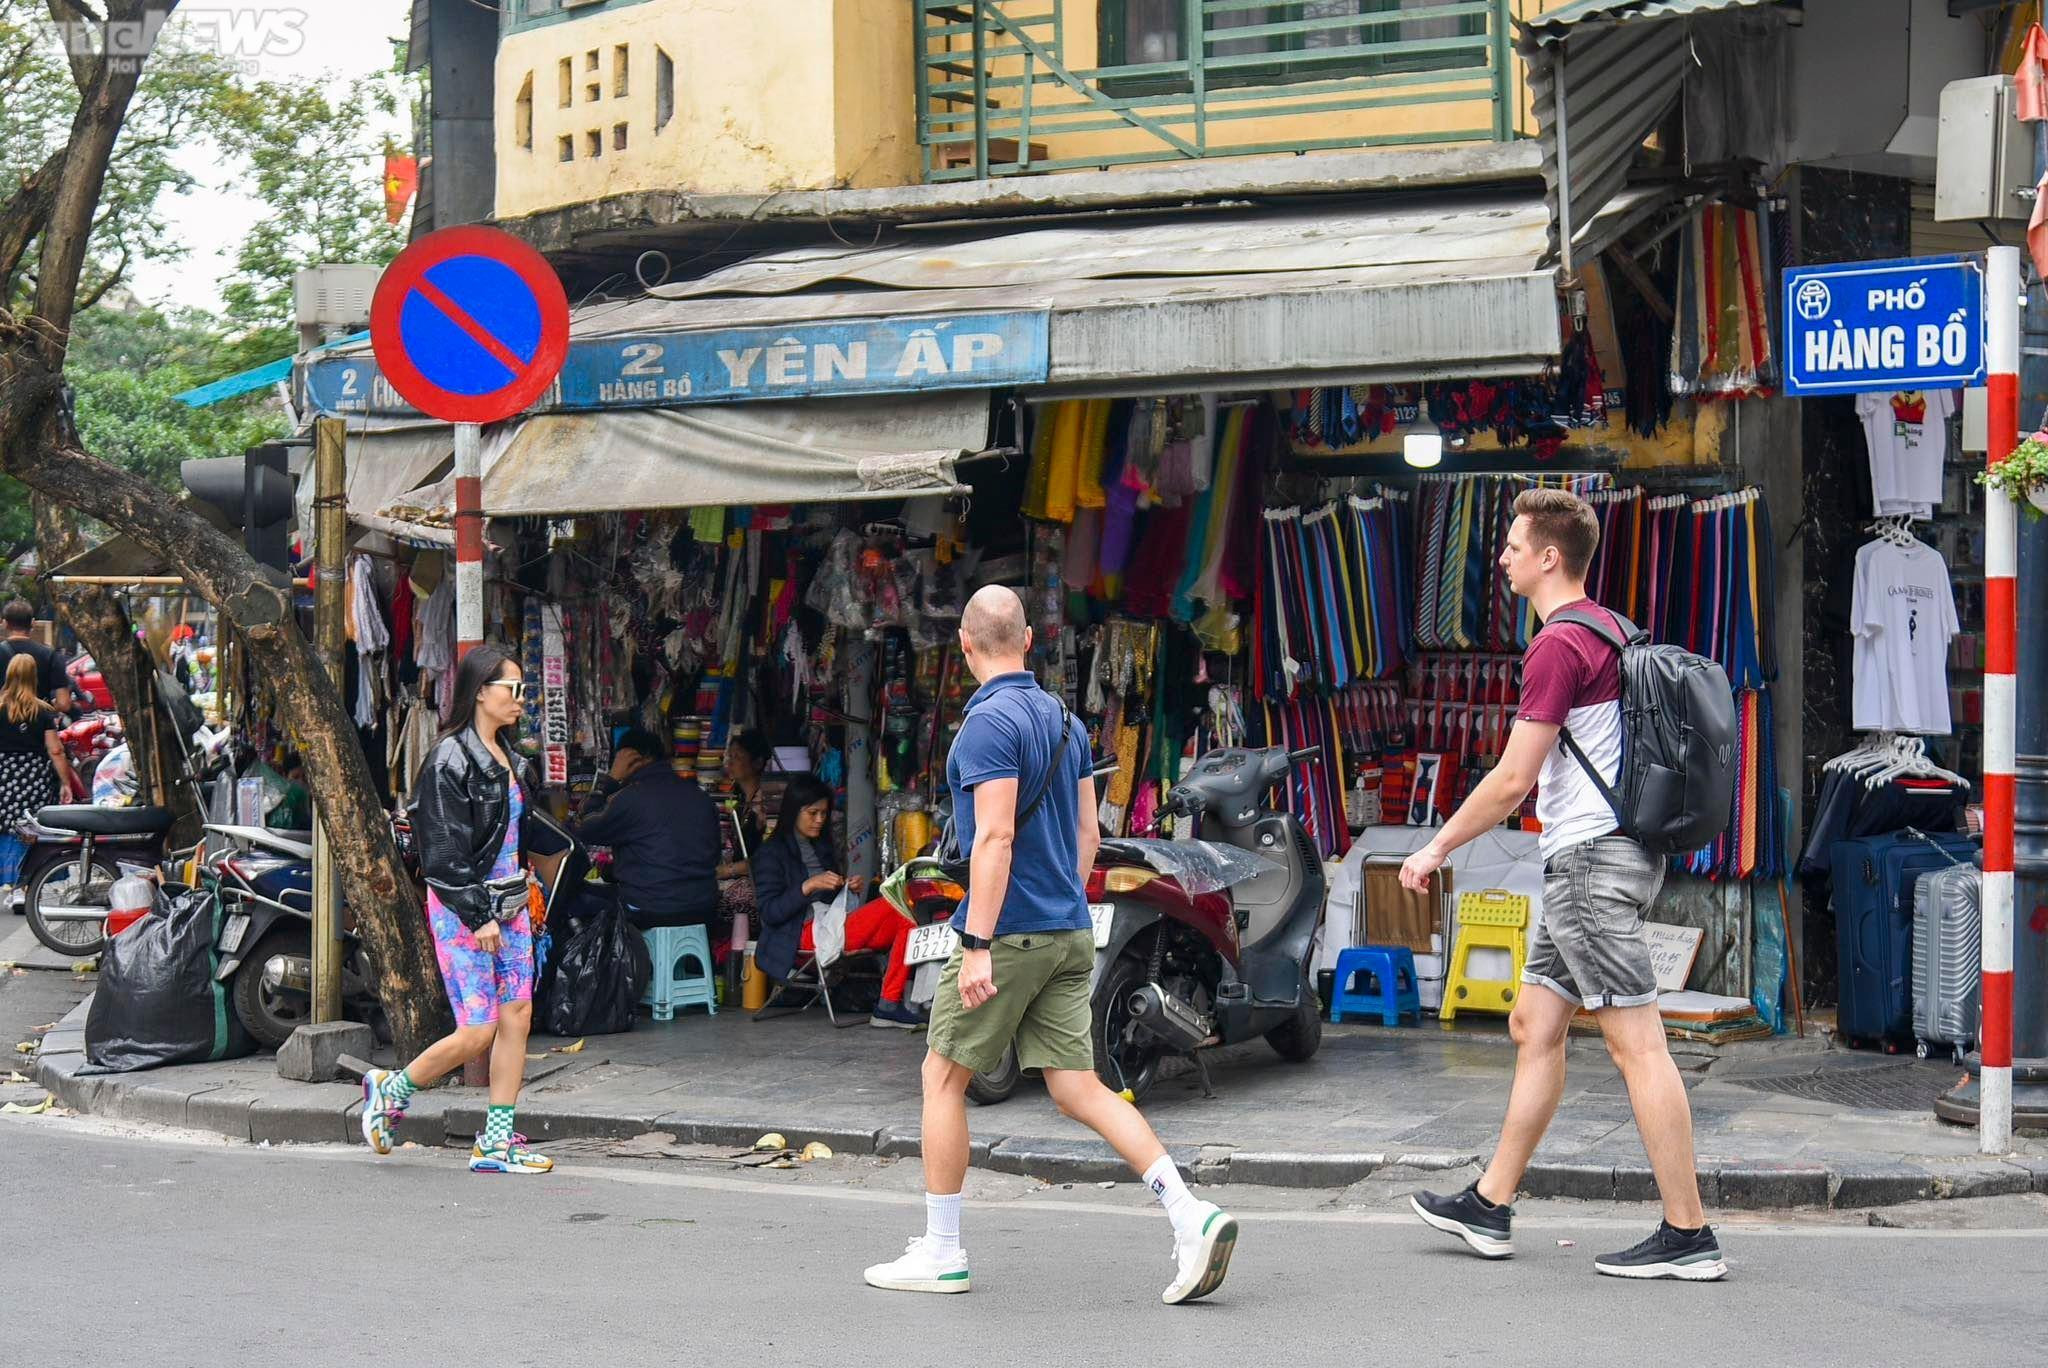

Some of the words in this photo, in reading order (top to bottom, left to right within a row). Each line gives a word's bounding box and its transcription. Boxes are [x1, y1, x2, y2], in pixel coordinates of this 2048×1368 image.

[1867, 277, 1929, 312] PHỐ
[716, 335, 869, 388] YÊN
[894, 320, 1005, 378] ẤP
[1804, 318, 1906, 373] HÀNG
[1916, 307, 1969, 368] BỒ
[622, 342, 665, 376] 2
[341, 368, 358, 395] 2
[600, 376, 657, 402] HÀNG
